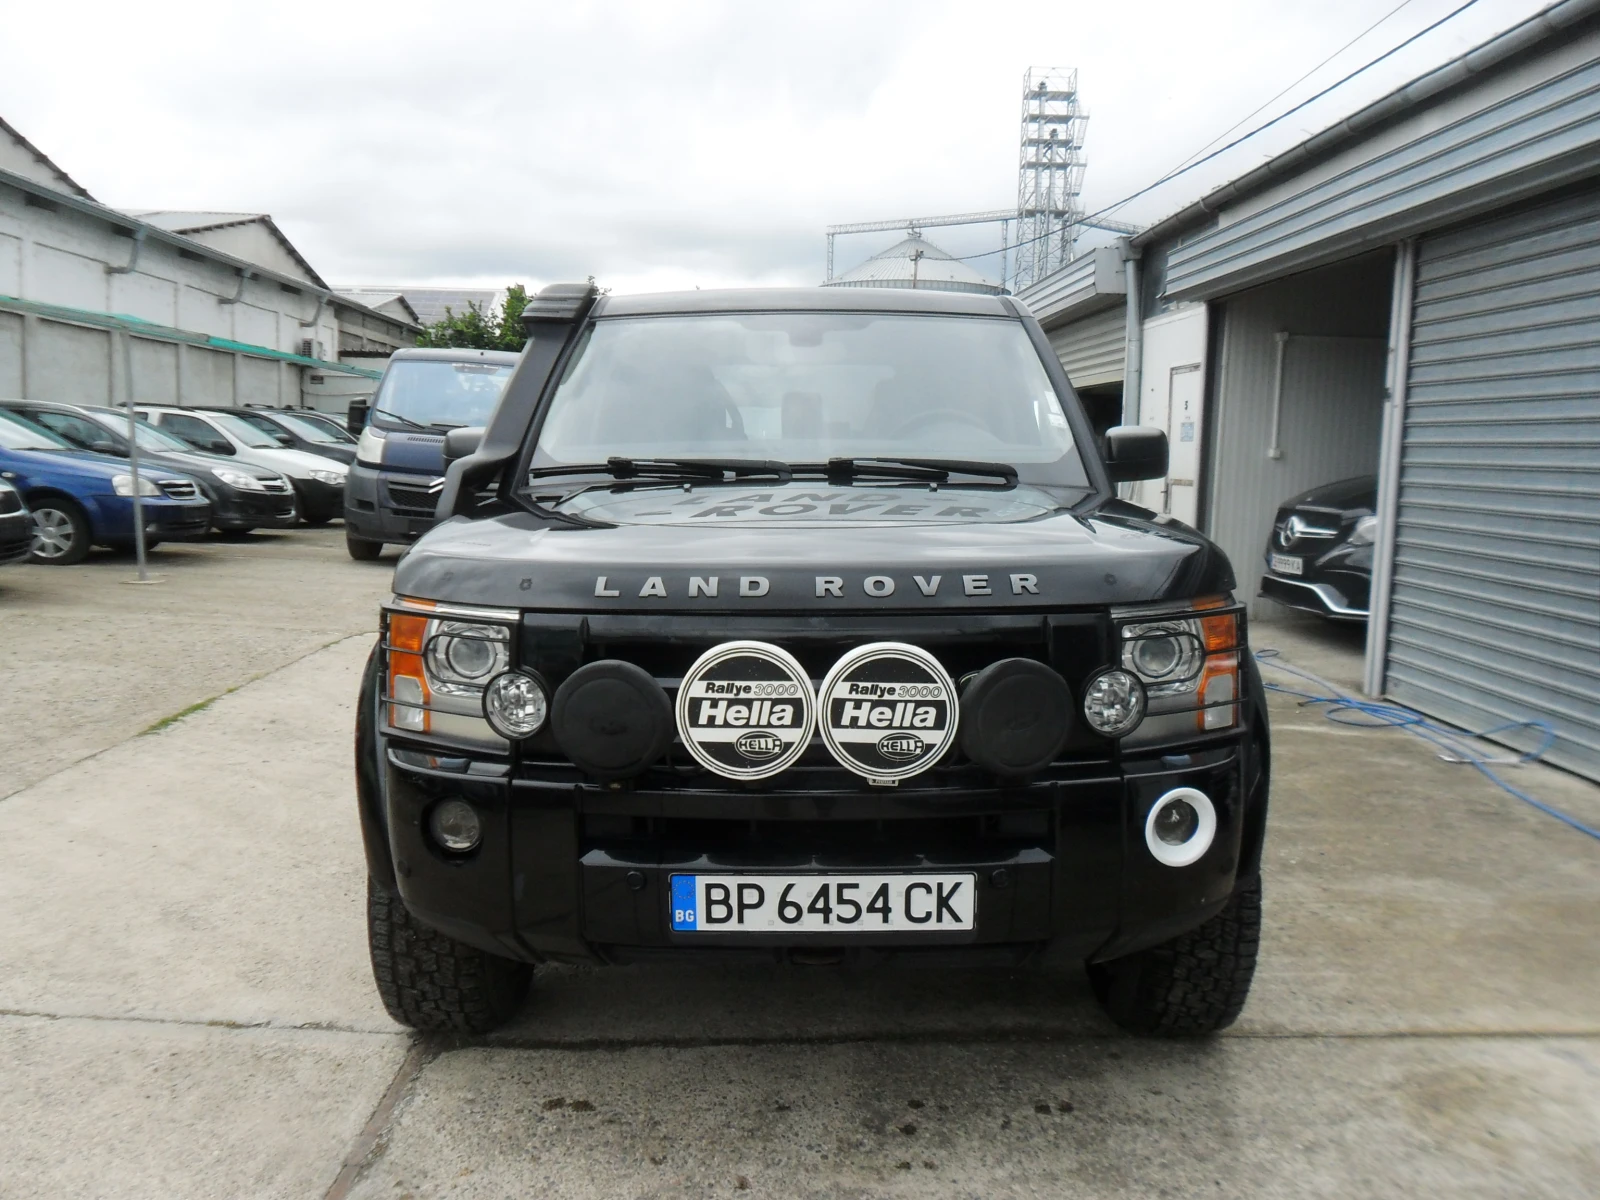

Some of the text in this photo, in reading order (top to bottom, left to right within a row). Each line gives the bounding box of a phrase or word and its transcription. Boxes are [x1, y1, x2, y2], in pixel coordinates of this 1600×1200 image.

[672, 493, 901, 506] LAND
[688, 503, 992, 519] ROVER
[594, 573, 1041, 598] LAND ROVER
[705, 682, 798, 697] Rallye 3000
[848, 683, 942, 698] Rallye 3000
[698, 700, 794, 726] Hella
[840, 701, 937, 728] Hella
[739, 738, 782, 752] HELLA
[880, 740, 924, 753] HELLA
[704, 881, 964, 924] BP 6454 CK
[675, 909, 695, 922] BG
